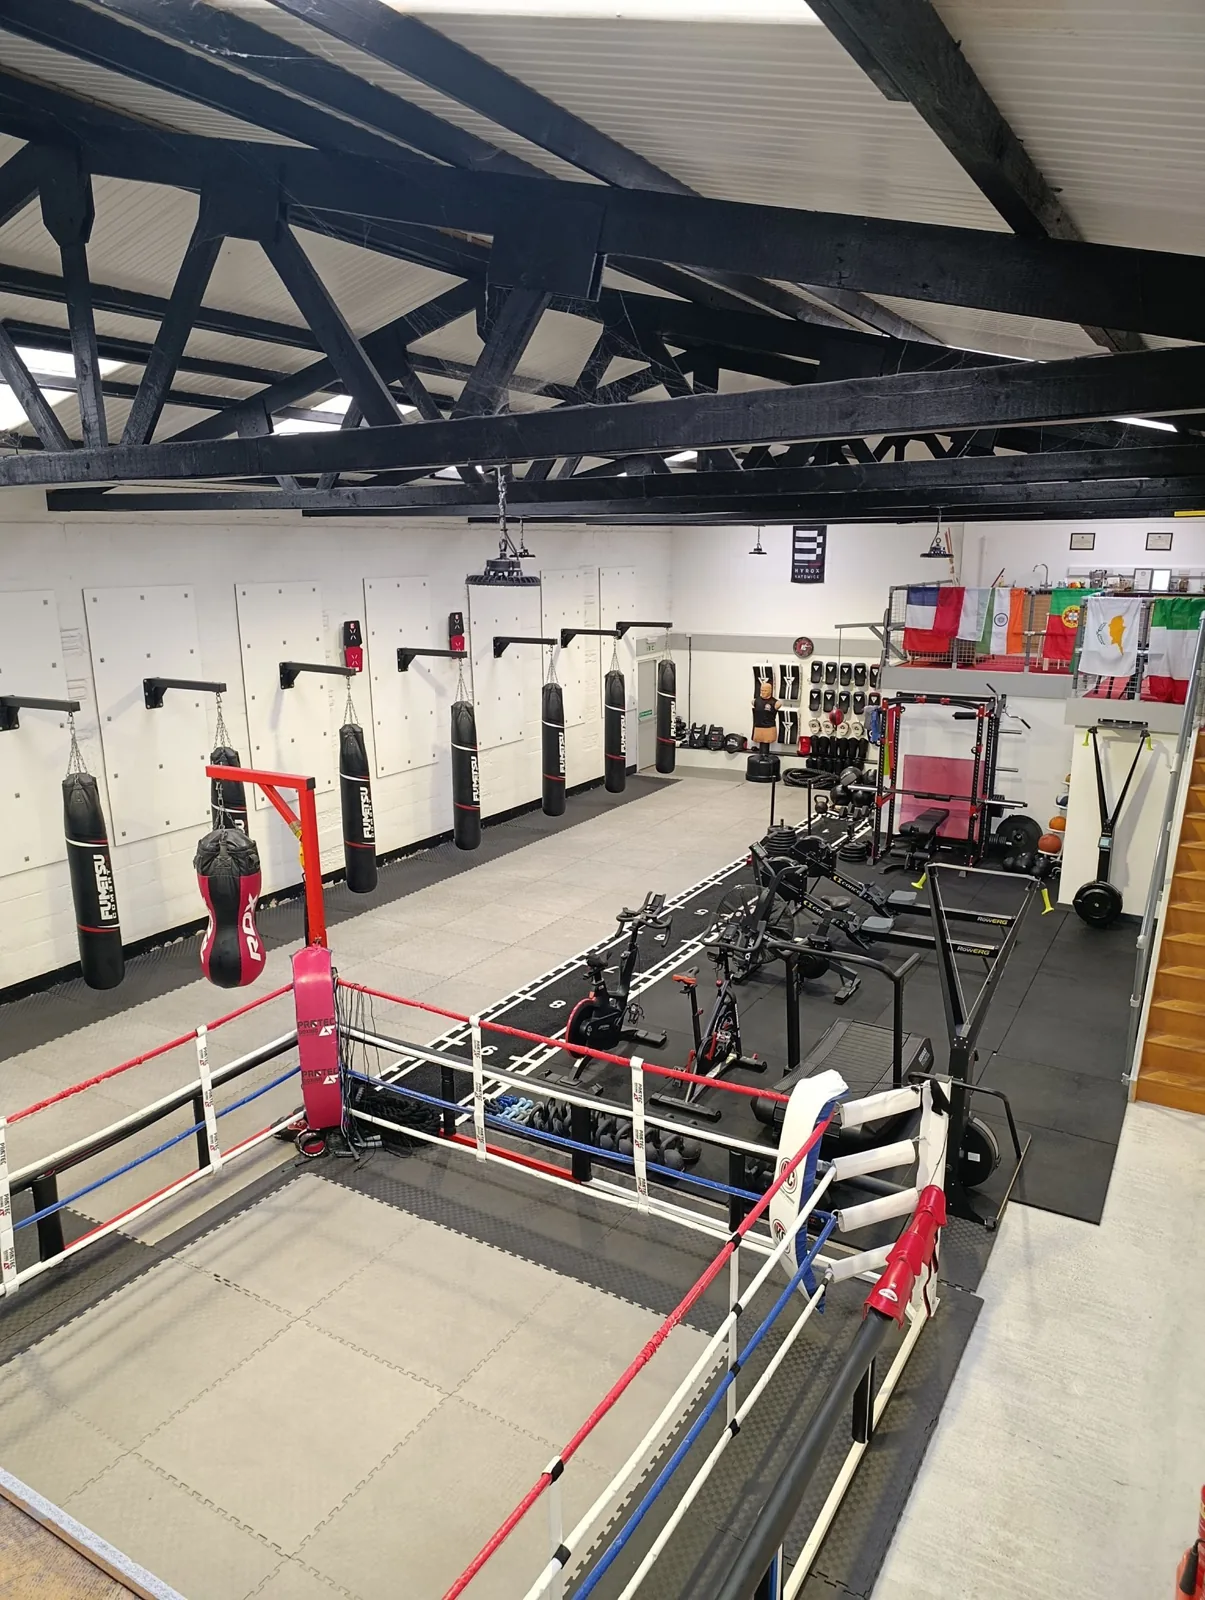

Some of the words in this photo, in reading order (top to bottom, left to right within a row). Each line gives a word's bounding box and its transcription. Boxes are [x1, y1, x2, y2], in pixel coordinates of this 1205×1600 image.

[359, 786, 372, 839] FUMETSU
[93, 854, 114, 920] FUMETSU
[242, 892, 262, 962] RDX
